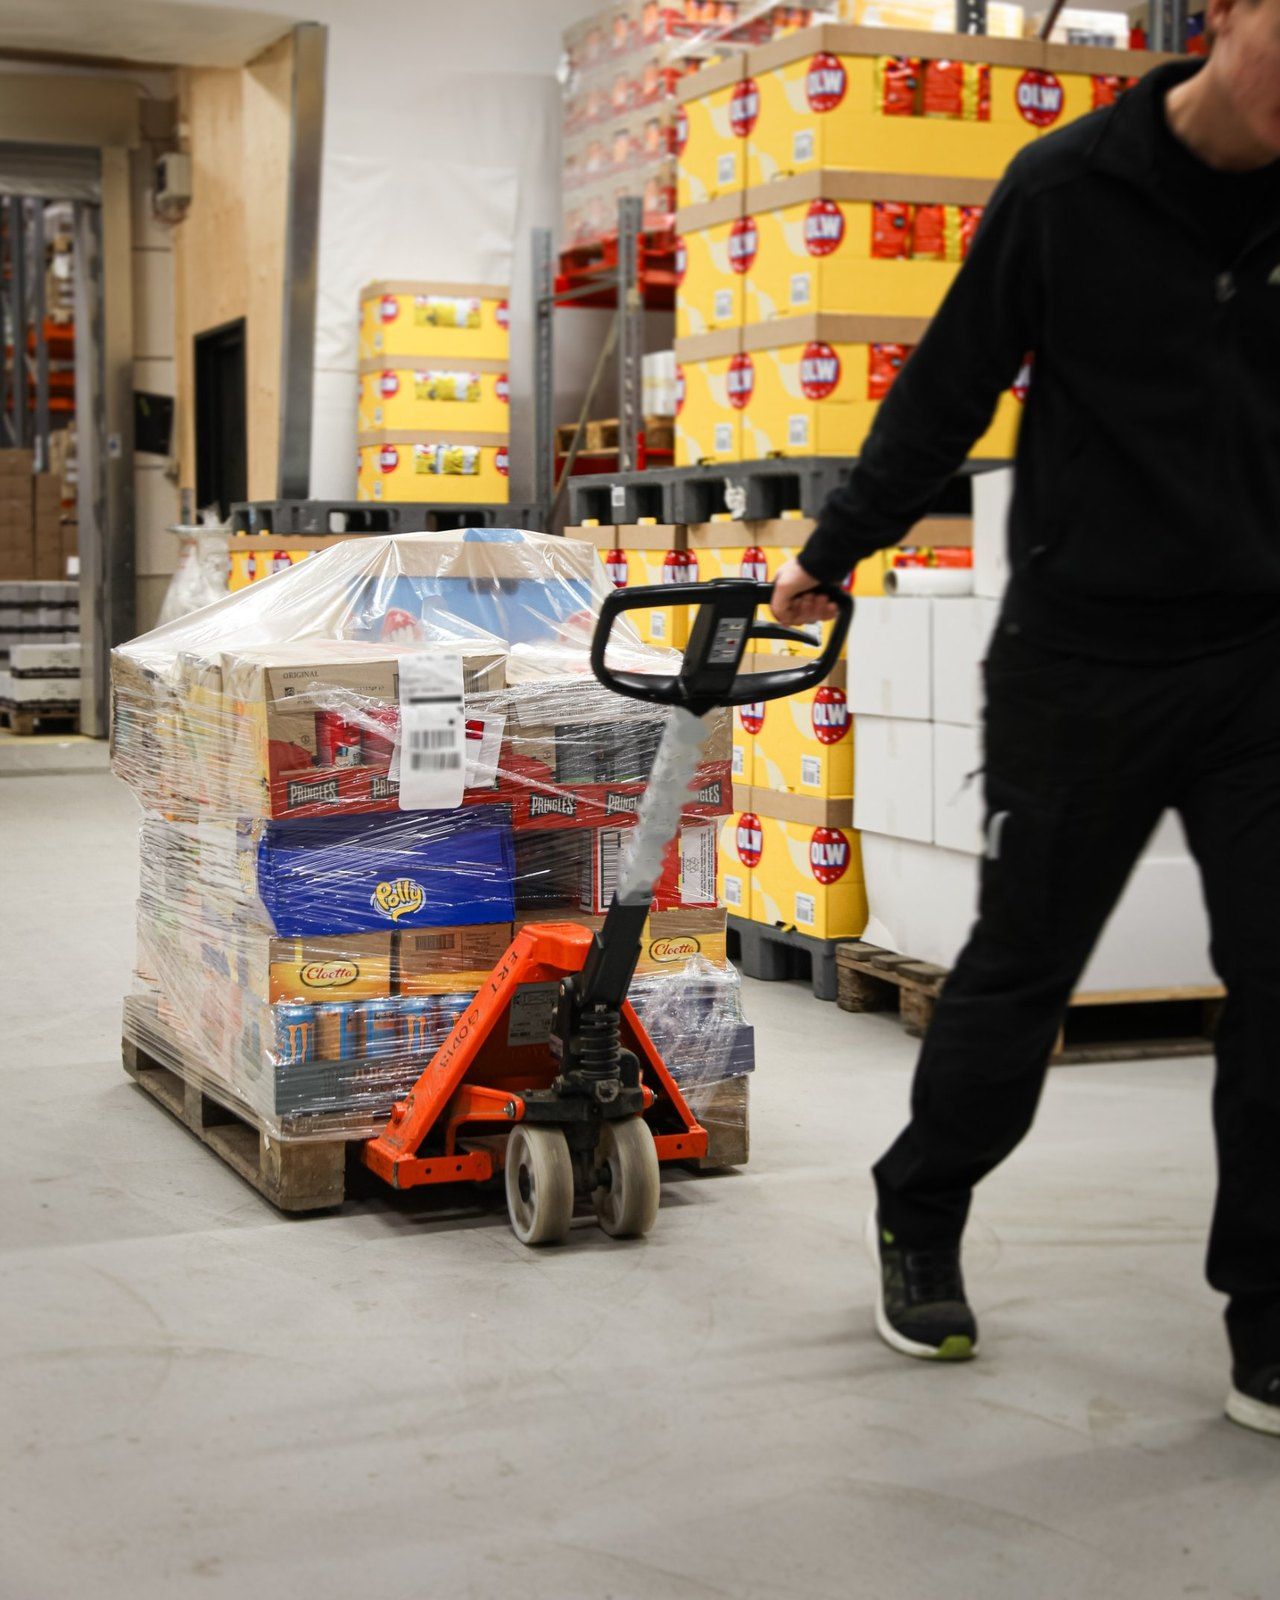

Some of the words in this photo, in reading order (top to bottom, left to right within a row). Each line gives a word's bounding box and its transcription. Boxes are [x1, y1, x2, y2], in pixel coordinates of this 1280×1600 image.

[1019, 83, 1059, 112] OLW
[283, 671, 319, 679] ORIGINAL
[813, 703, 847, 725] OLW
[289, 781, 337, 804] PRINGLES
[531, 796, 574, 816] PRINGLES
[811, 841, 847, 865] OLW
[375, 880, 422, 922] Polly
[653, 943, 695, 956] Cloetta
[306, 967, 352, 980] Cloetta
